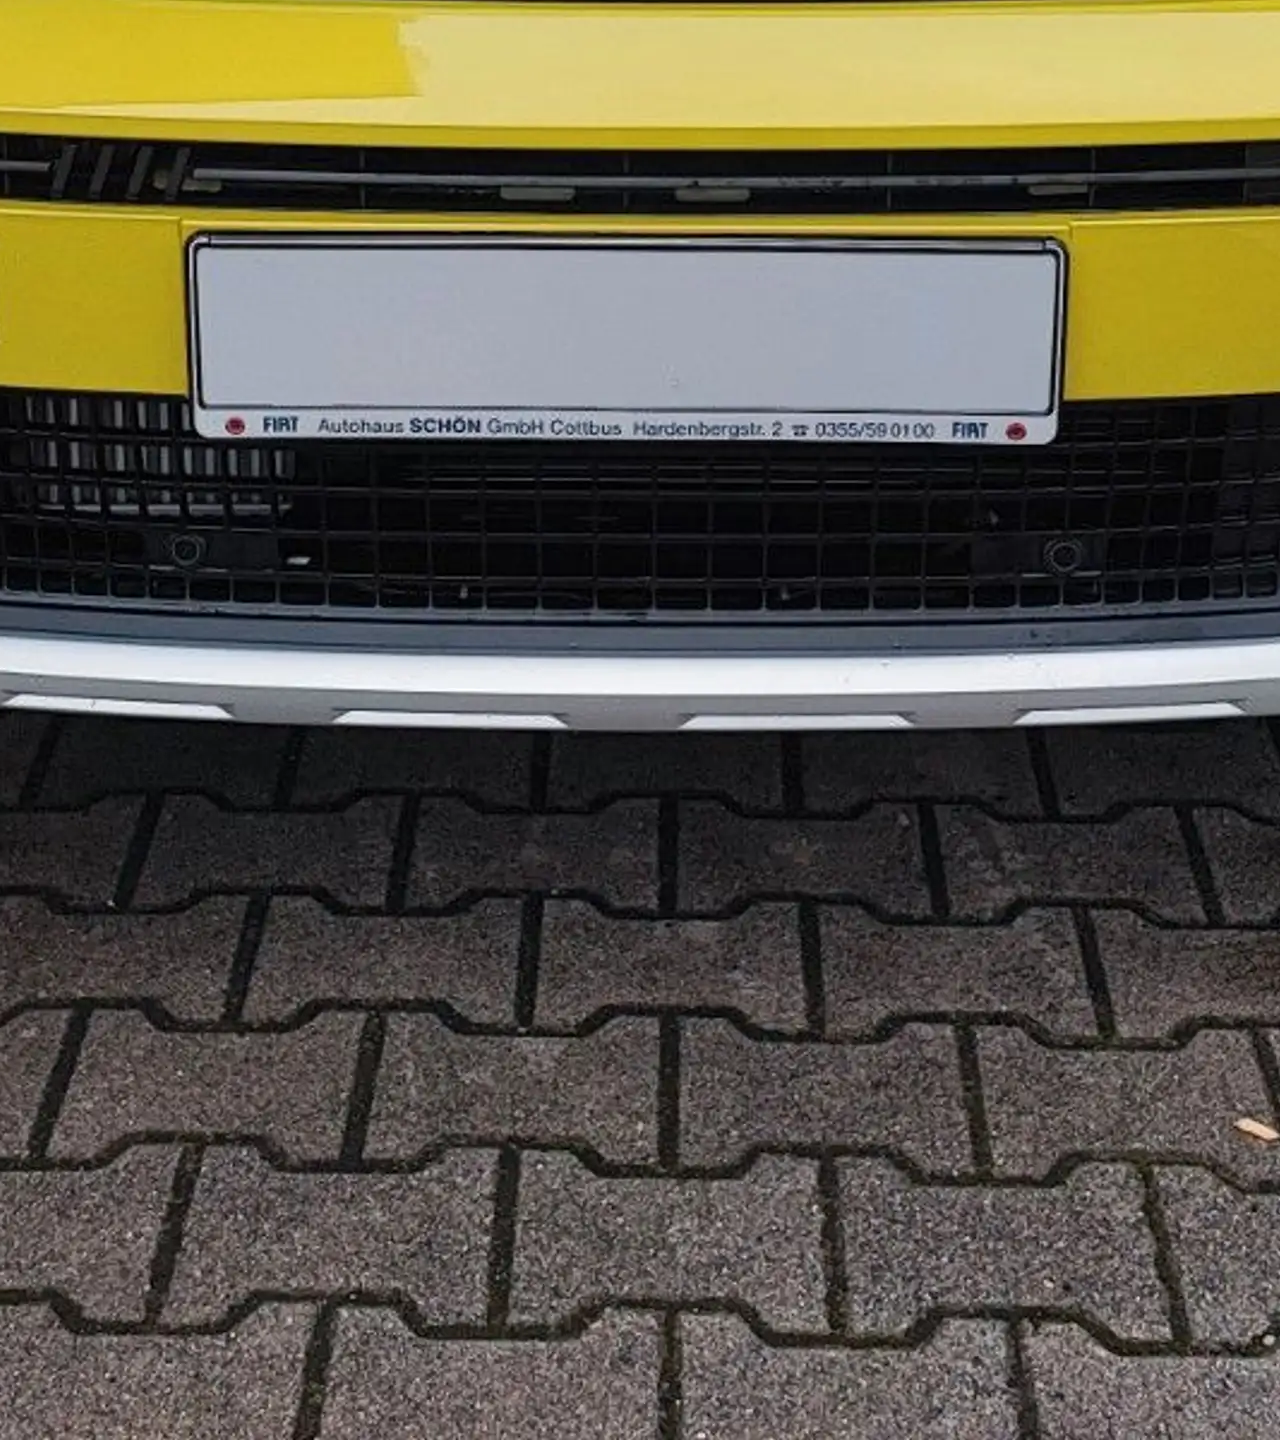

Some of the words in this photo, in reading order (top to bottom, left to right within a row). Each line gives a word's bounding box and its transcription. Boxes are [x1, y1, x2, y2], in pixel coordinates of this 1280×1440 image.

[263, 416, 300, 433] FIAT
[317, 417, 404, 434] Autohaus
[409, 416, 481, 434] SCHÖN
[486, 417, 545, 436] GmbH
[551, 418, 622, 436] Cottbus
[633, 420, 766, 439] Hardenbergstr.
[771, 420, 783, 437] 2
[951, 422, 989, 439] FIAT
